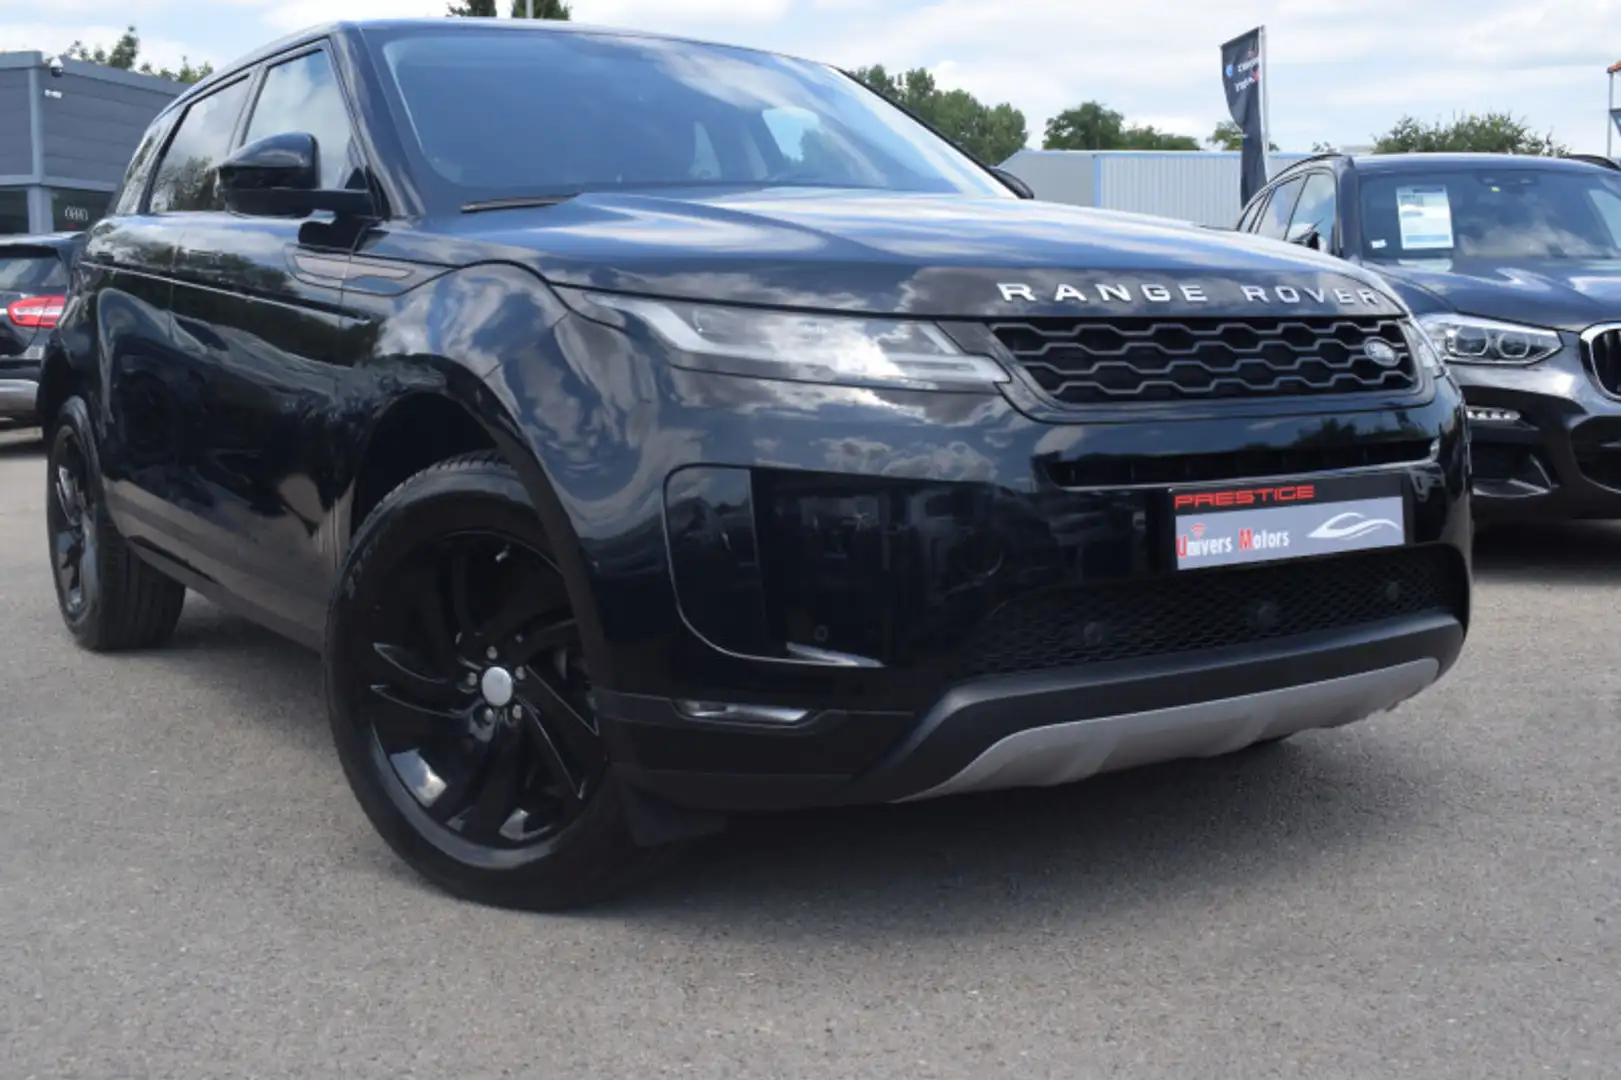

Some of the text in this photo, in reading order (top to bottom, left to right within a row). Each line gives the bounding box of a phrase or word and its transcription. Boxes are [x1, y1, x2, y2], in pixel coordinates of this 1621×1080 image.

[996, 283, 1379, 304] RANGE ROVER
[1174, 484, 1315, 510] PRESTIGE
[1239, 528, 1290, 552] Motors
